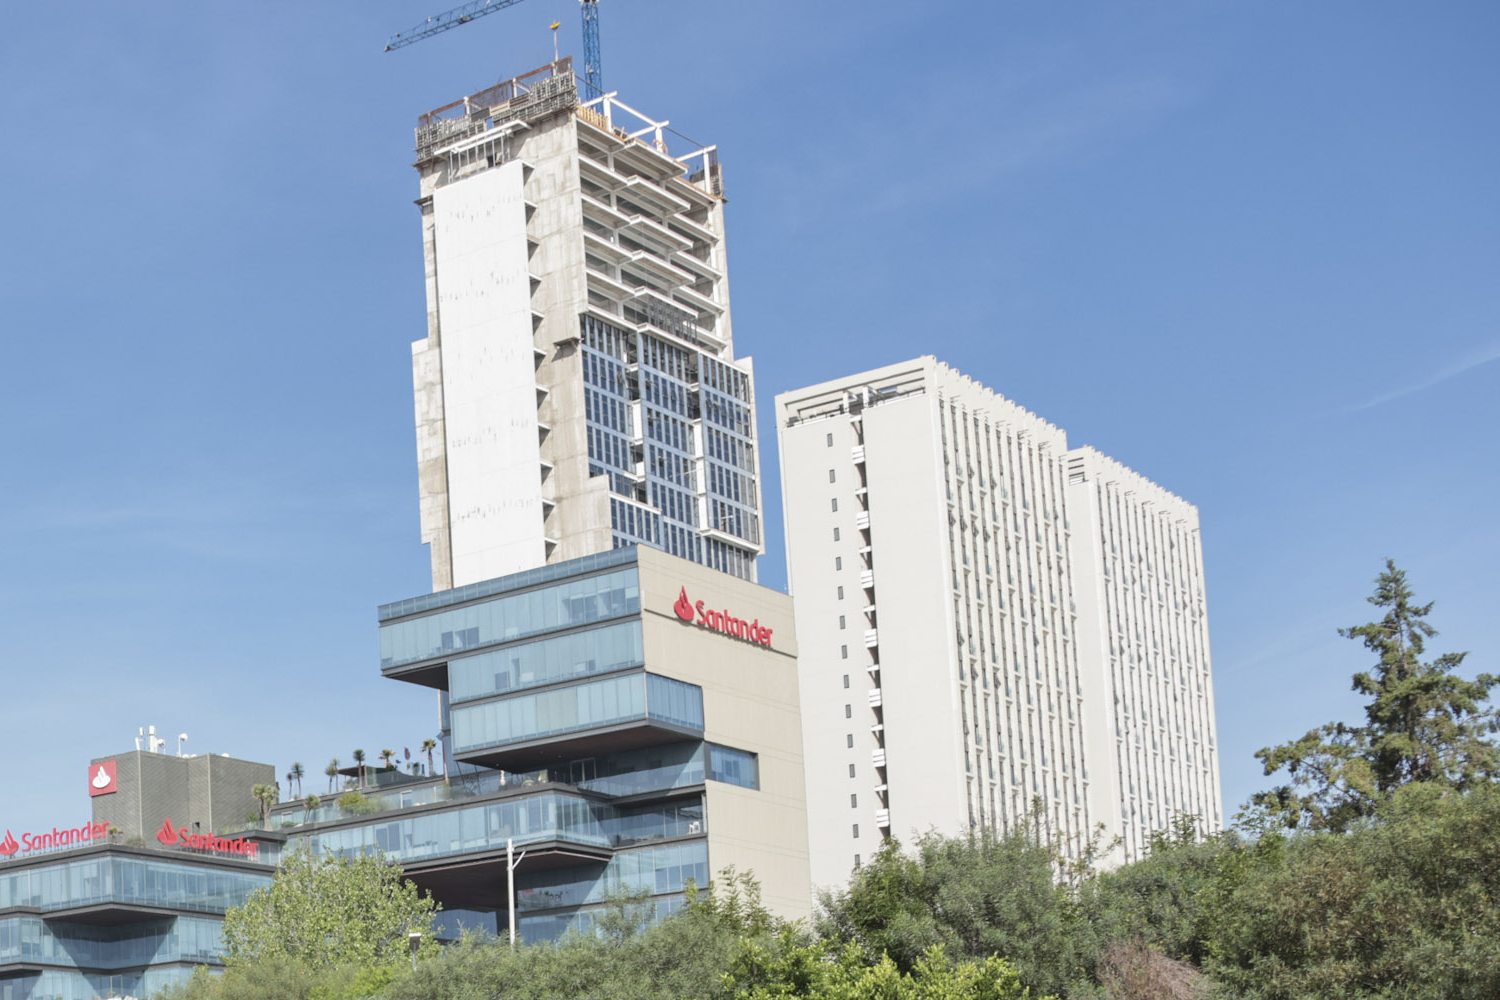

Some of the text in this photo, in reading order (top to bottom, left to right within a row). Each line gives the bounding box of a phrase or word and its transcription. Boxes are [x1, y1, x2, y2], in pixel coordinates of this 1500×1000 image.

[695, 599, 773, 646] Santander
[21, 821, 110, 853] Santander
[180, 828, 259, 857] Santander
